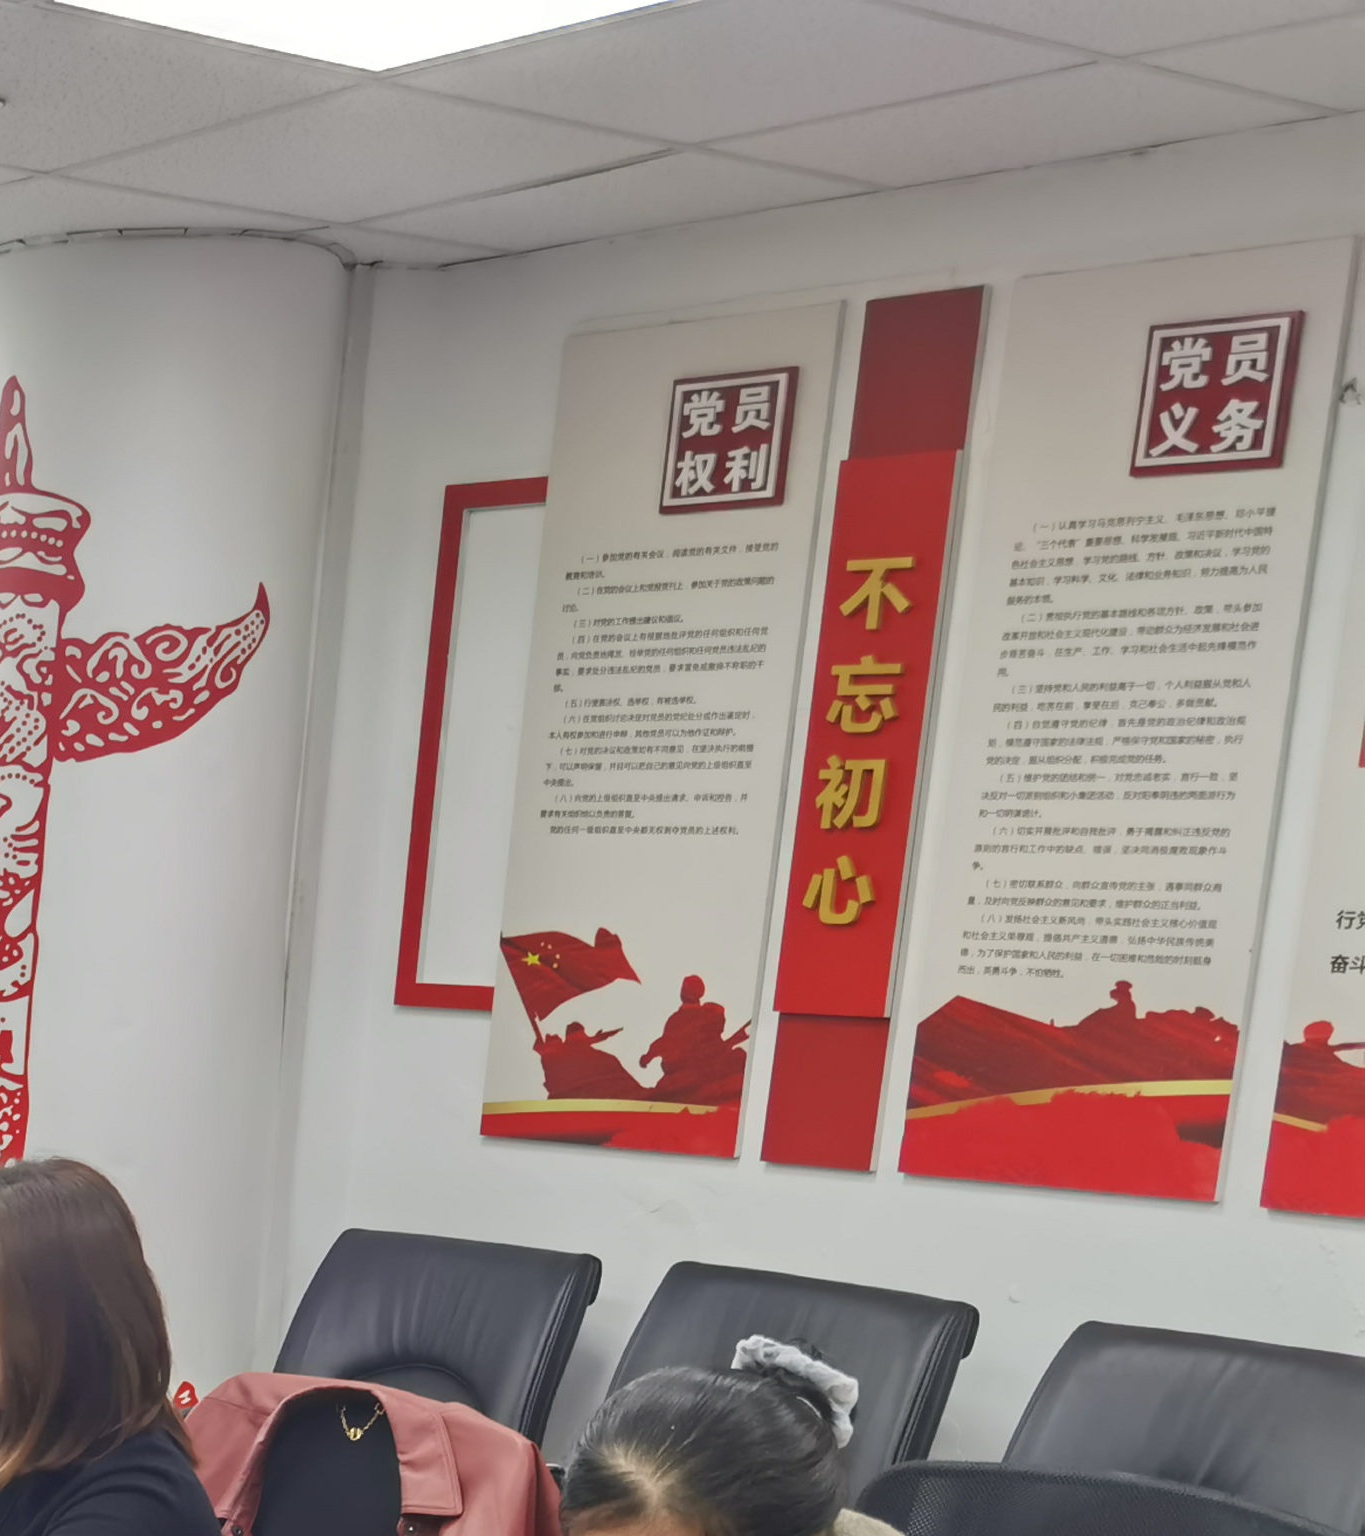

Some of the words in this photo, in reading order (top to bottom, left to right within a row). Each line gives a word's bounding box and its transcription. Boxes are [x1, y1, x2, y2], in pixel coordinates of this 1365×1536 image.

[1159, 332, 1269, 391] 党员
[681, 386, 771, 438] 党员
[1149, 399, 1264, 458] 义务
[675, 444, 769, 496] 权利
[802, 558, 915, 925] 不忘初心
